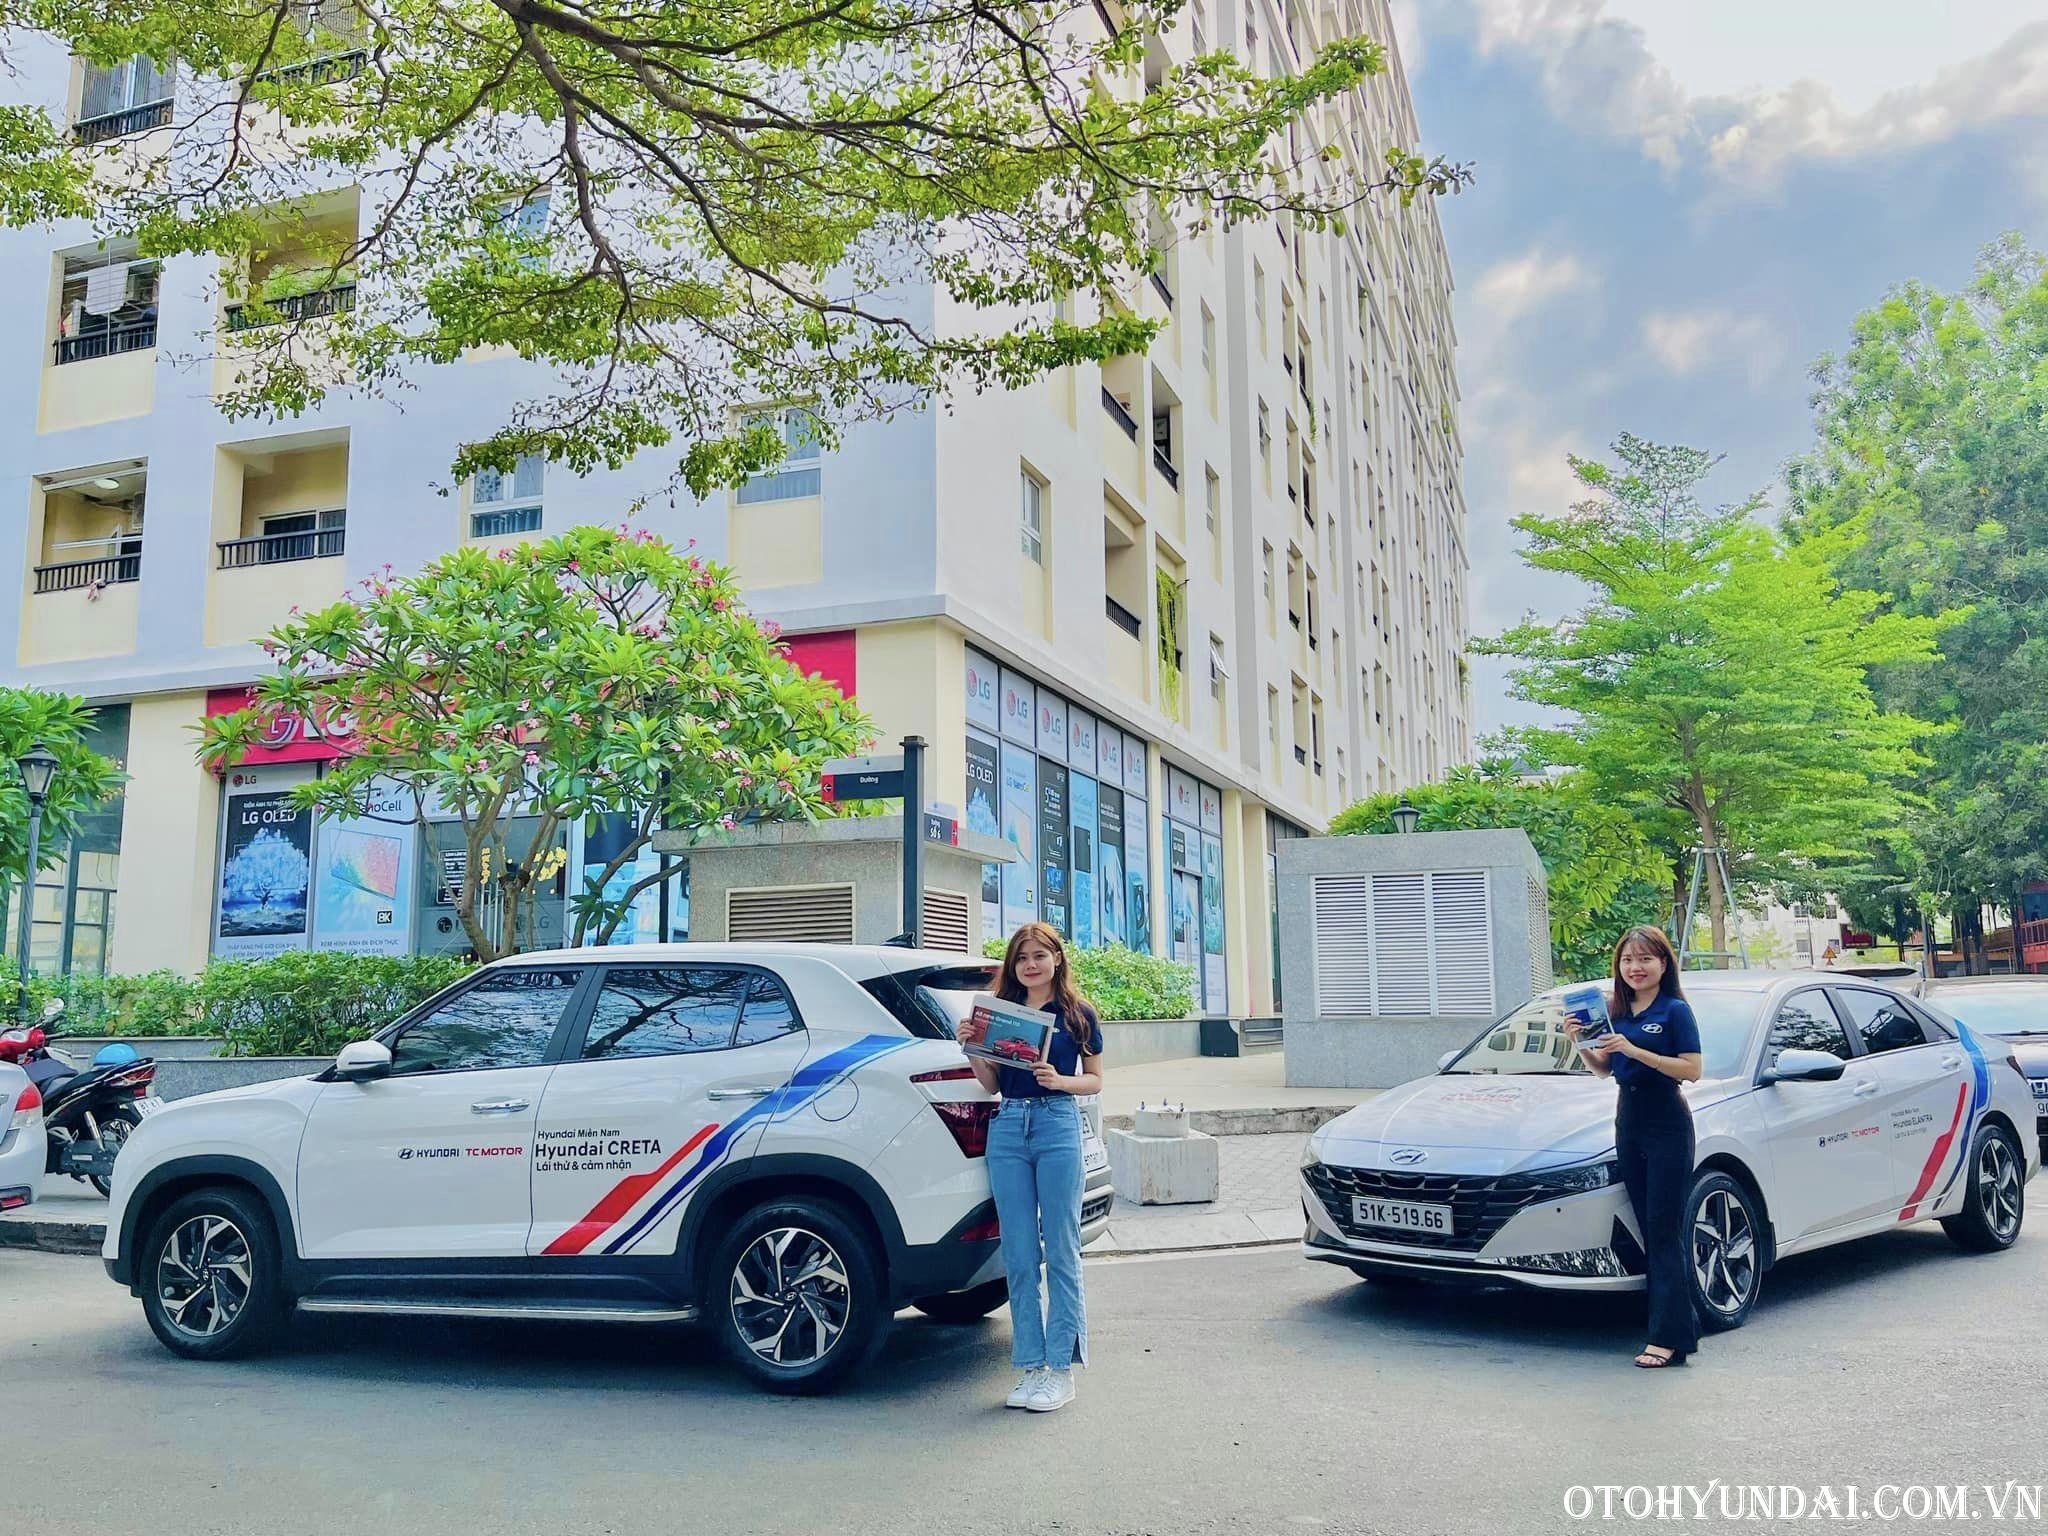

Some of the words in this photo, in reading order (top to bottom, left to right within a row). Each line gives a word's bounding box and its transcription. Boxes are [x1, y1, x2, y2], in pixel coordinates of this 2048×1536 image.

[978, 677, 991, 700] LG
[1017, 696, 1028, 719] LG
[1051, 717, 1061, 736] LG
[1081, 731, 1090, 749] LG
[244, 775, 257, 785] LG
[976, 766, 994, 784] OLED
[242, 811, 259, 825] LG
[262, 809, 297, 823] OLED
[537, 1128, 576, 1141] Hyundai
[600, 1128, 620, 1137] Nam
[416, 1147, 460, 1158] HYUNDAI
[535, 1140, 604, 1161] Hyundai
[607, 1139, 662, 1156] CRETA
[536, 1160, 552, 1172] Lái
[553, 1160, 570, 1171] thử
[571, 1161, 579, 1170] &
[581, 1159, 604, 1170] cảm
[605, 1159, 632, 1172] nhận
[1359, 1202, 1443, 1229] 51K-519.66
